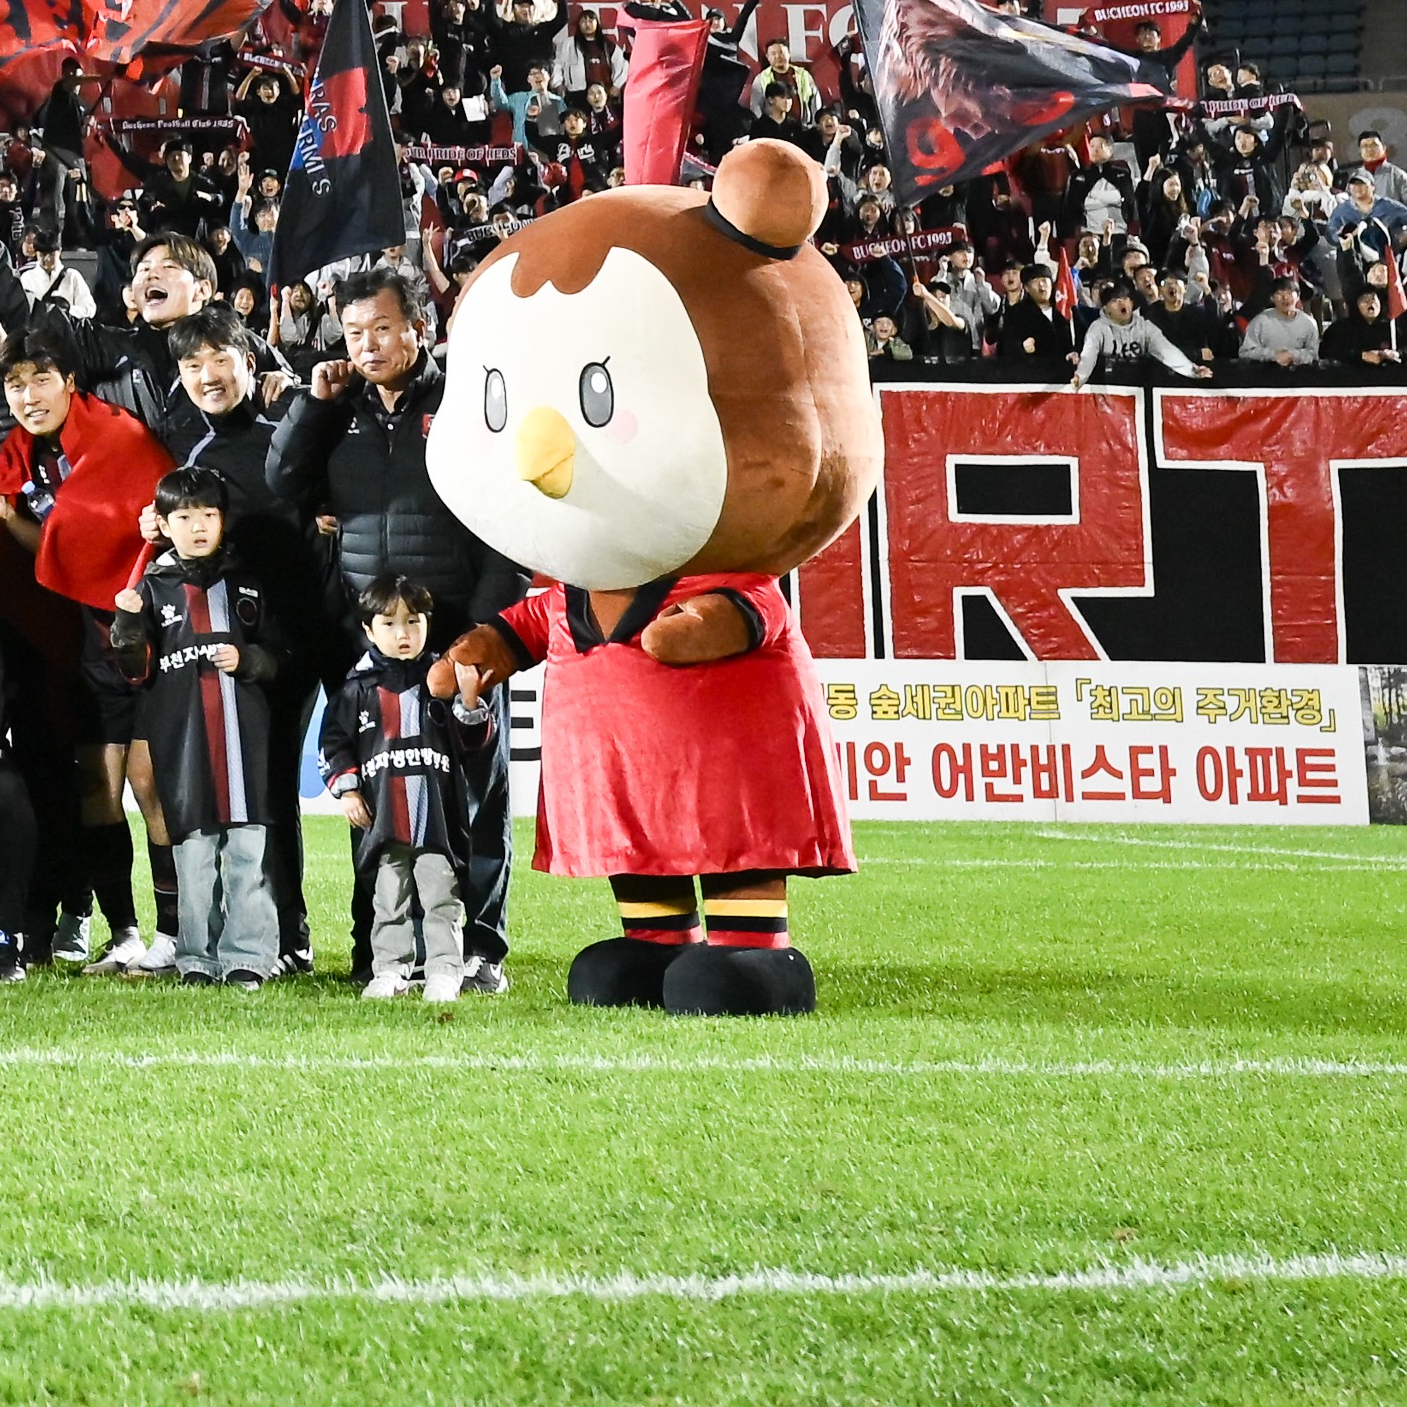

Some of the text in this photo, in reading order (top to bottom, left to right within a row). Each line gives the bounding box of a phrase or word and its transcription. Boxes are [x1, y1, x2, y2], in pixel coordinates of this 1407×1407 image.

[467, 148, 484, 160] OF
[870, 683, 1060, 721] 숲세권아파트
[931, 742, 1177, 805] 어반비스타
[1196, 743, 1342, 806] 아파트
